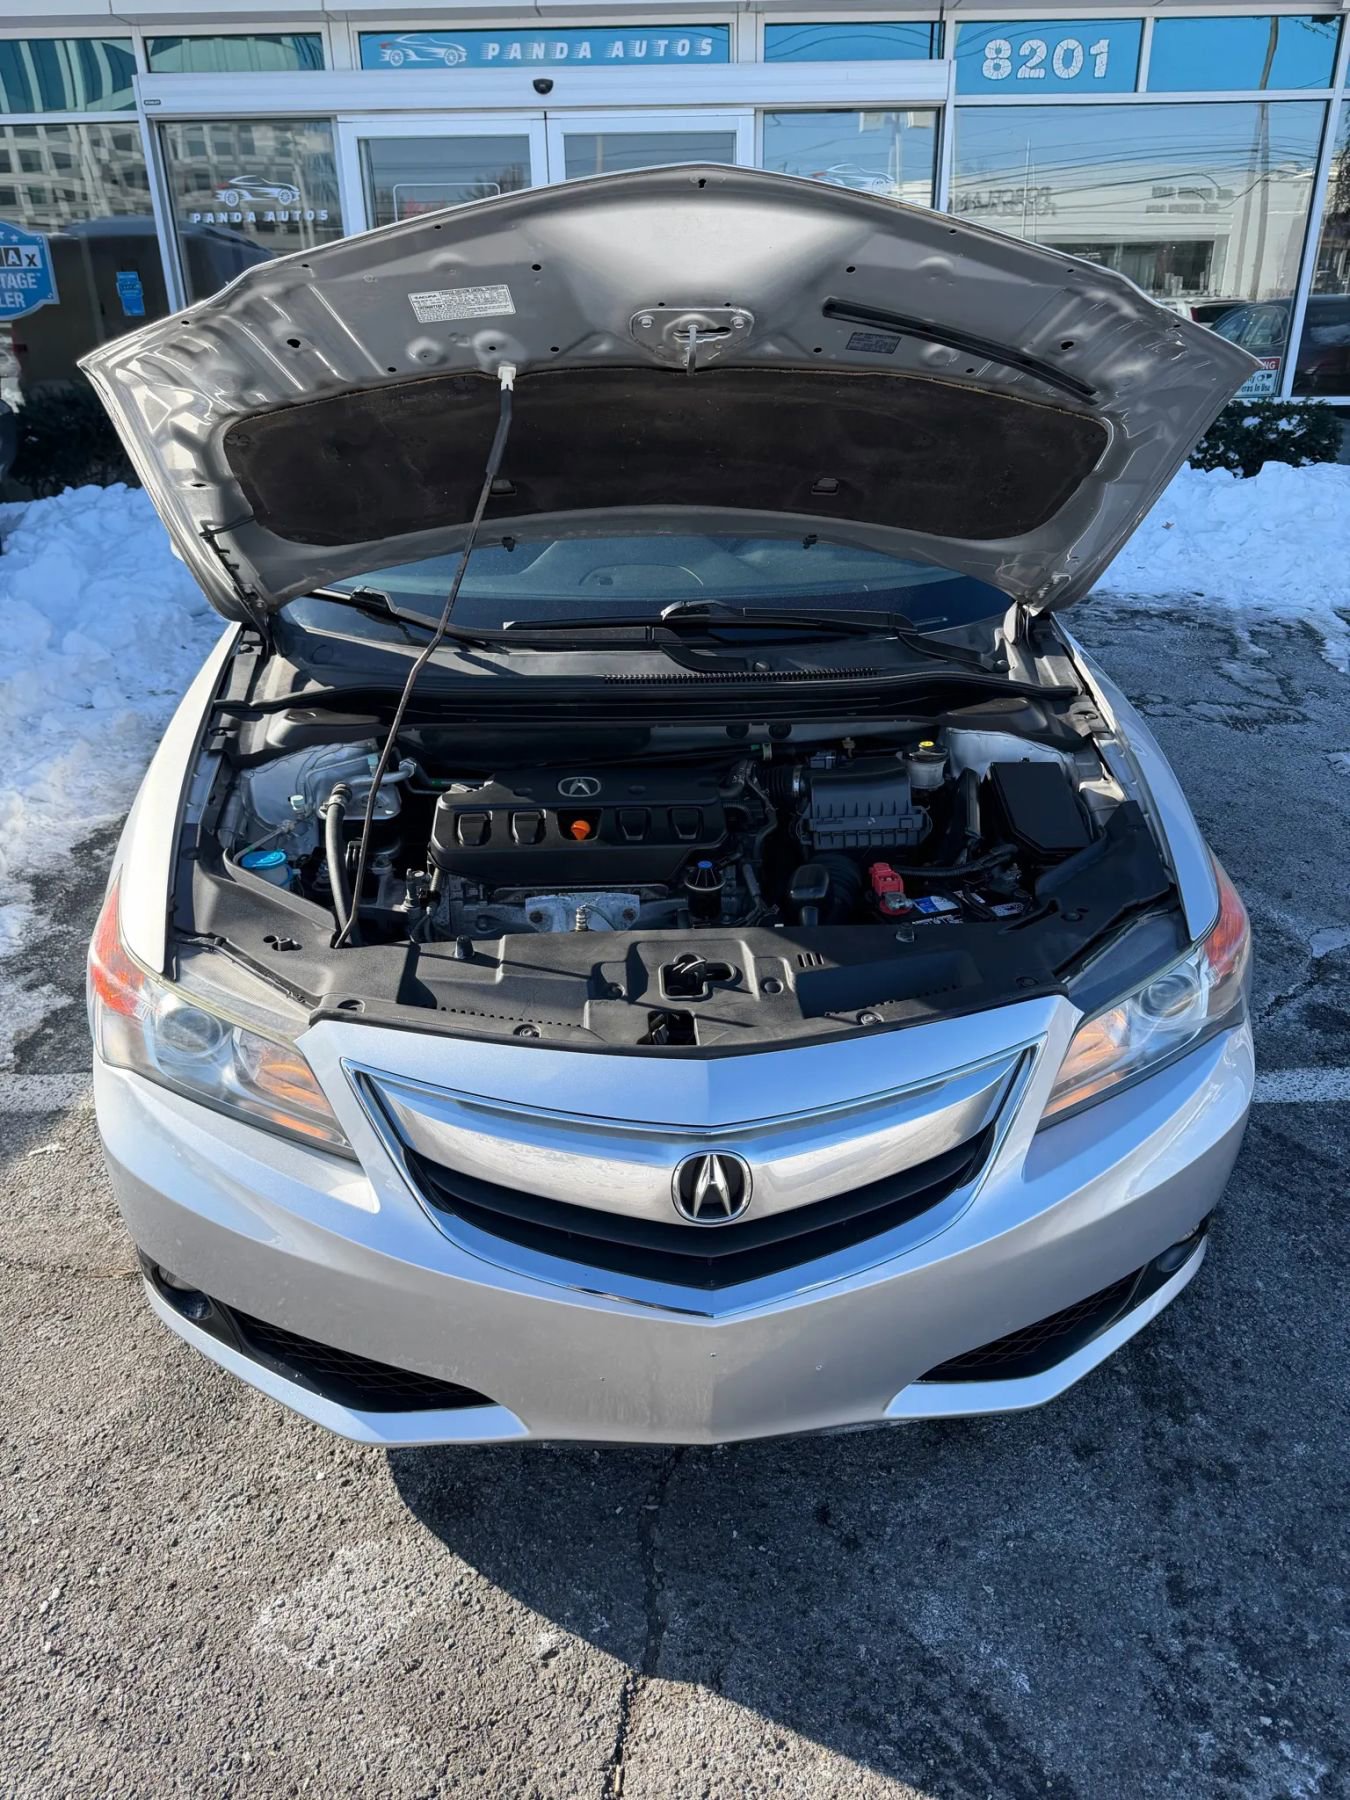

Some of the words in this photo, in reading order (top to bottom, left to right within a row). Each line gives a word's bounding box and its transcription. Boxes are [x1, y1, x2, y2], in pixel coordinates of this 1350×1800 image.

[481, 42, 592, 60] PANDA
[605, 38, 713, 58] AUTOS
[982, 38, 1110, 80] 8201
[190, 211, 256, 223] PANDA
[264, 209, 329, 222] AUTOS
